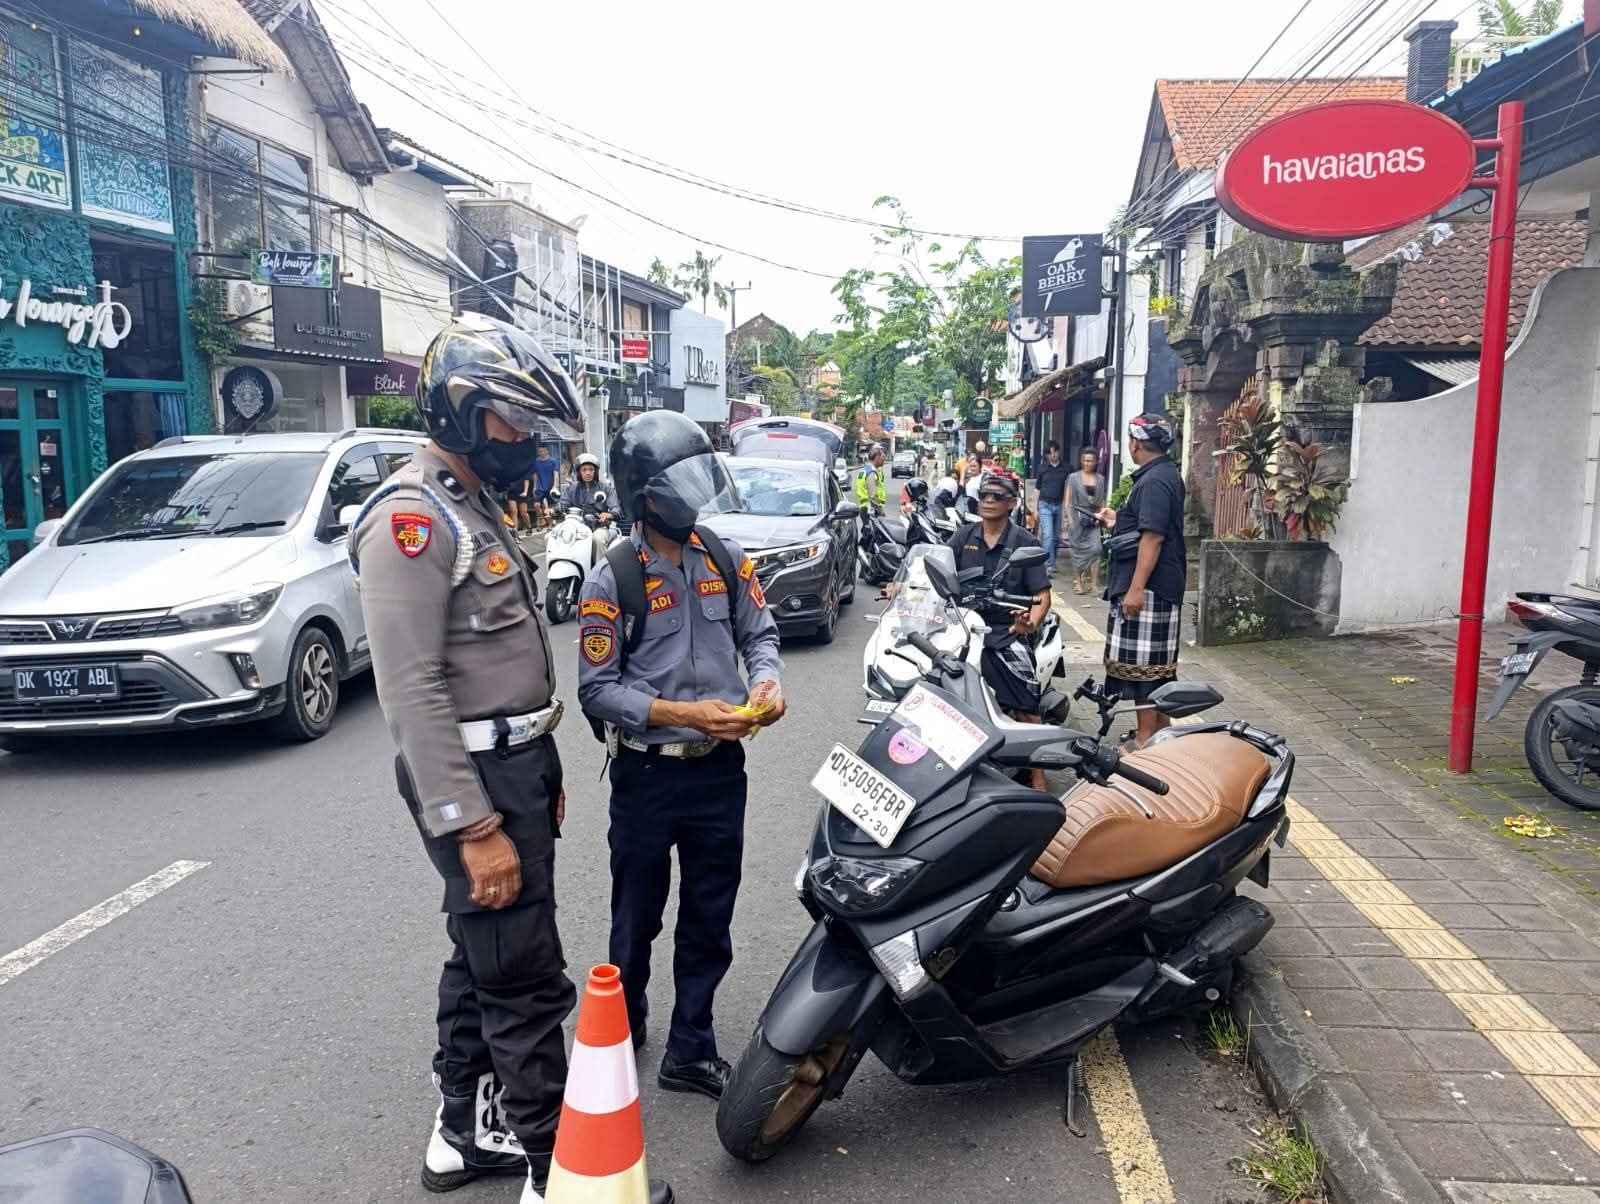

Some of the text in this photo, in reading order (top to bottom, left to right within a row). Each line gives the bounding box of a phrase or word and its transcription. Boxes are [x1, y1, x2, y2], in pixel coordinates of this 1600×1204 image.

[1263, 146, 1426, 185] havaianas
[26, 170, 64, 197] ART
[1038, 268, 1087, 290] BERRY
[1047, 260, 1077, 276] OAK
[374, 373, 407, 391] Blink
[651, 595, 674, 611] ADI
[17, 667, 114, 689] DK 1927 ABL
